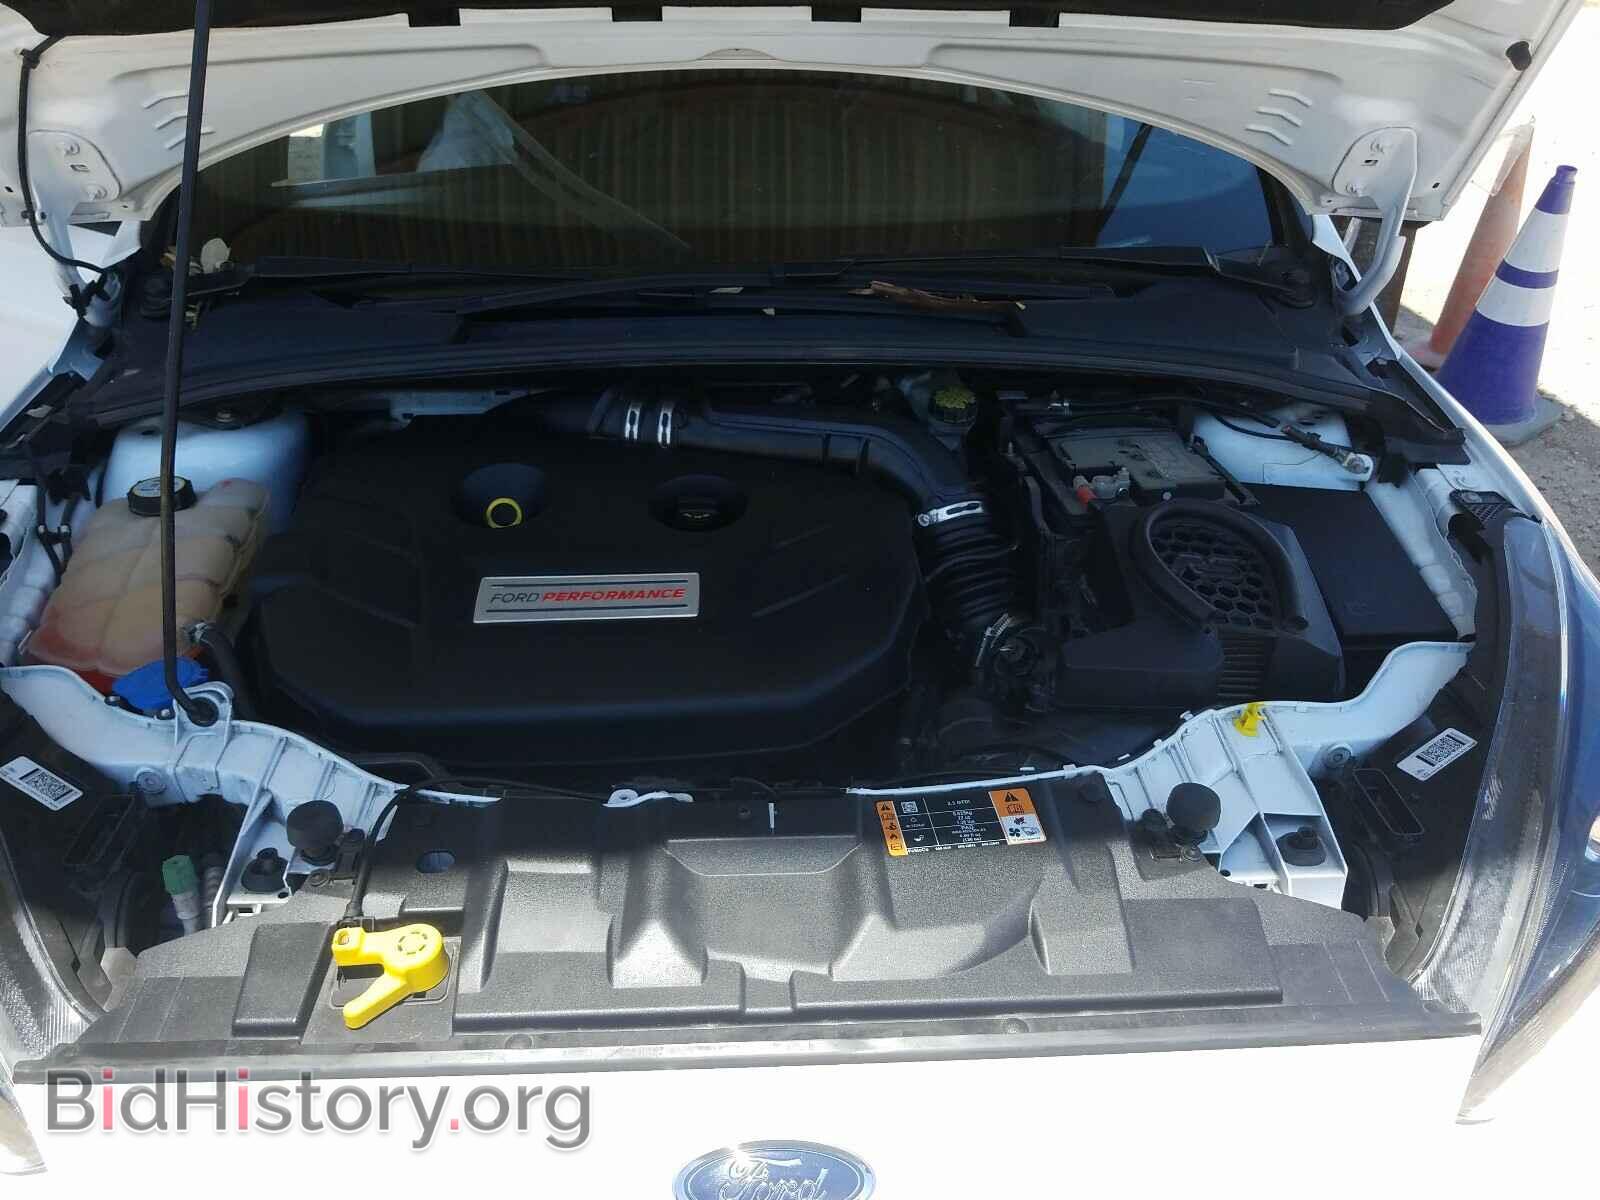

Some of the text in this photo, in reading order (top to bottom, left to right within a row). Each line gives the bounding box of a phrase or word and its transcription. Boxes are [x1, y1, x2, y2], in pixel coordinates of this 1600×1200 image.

[490, 588, 686, 604] FORD PERFORMANCE
[718, 1157, 829, 1200] Ford
